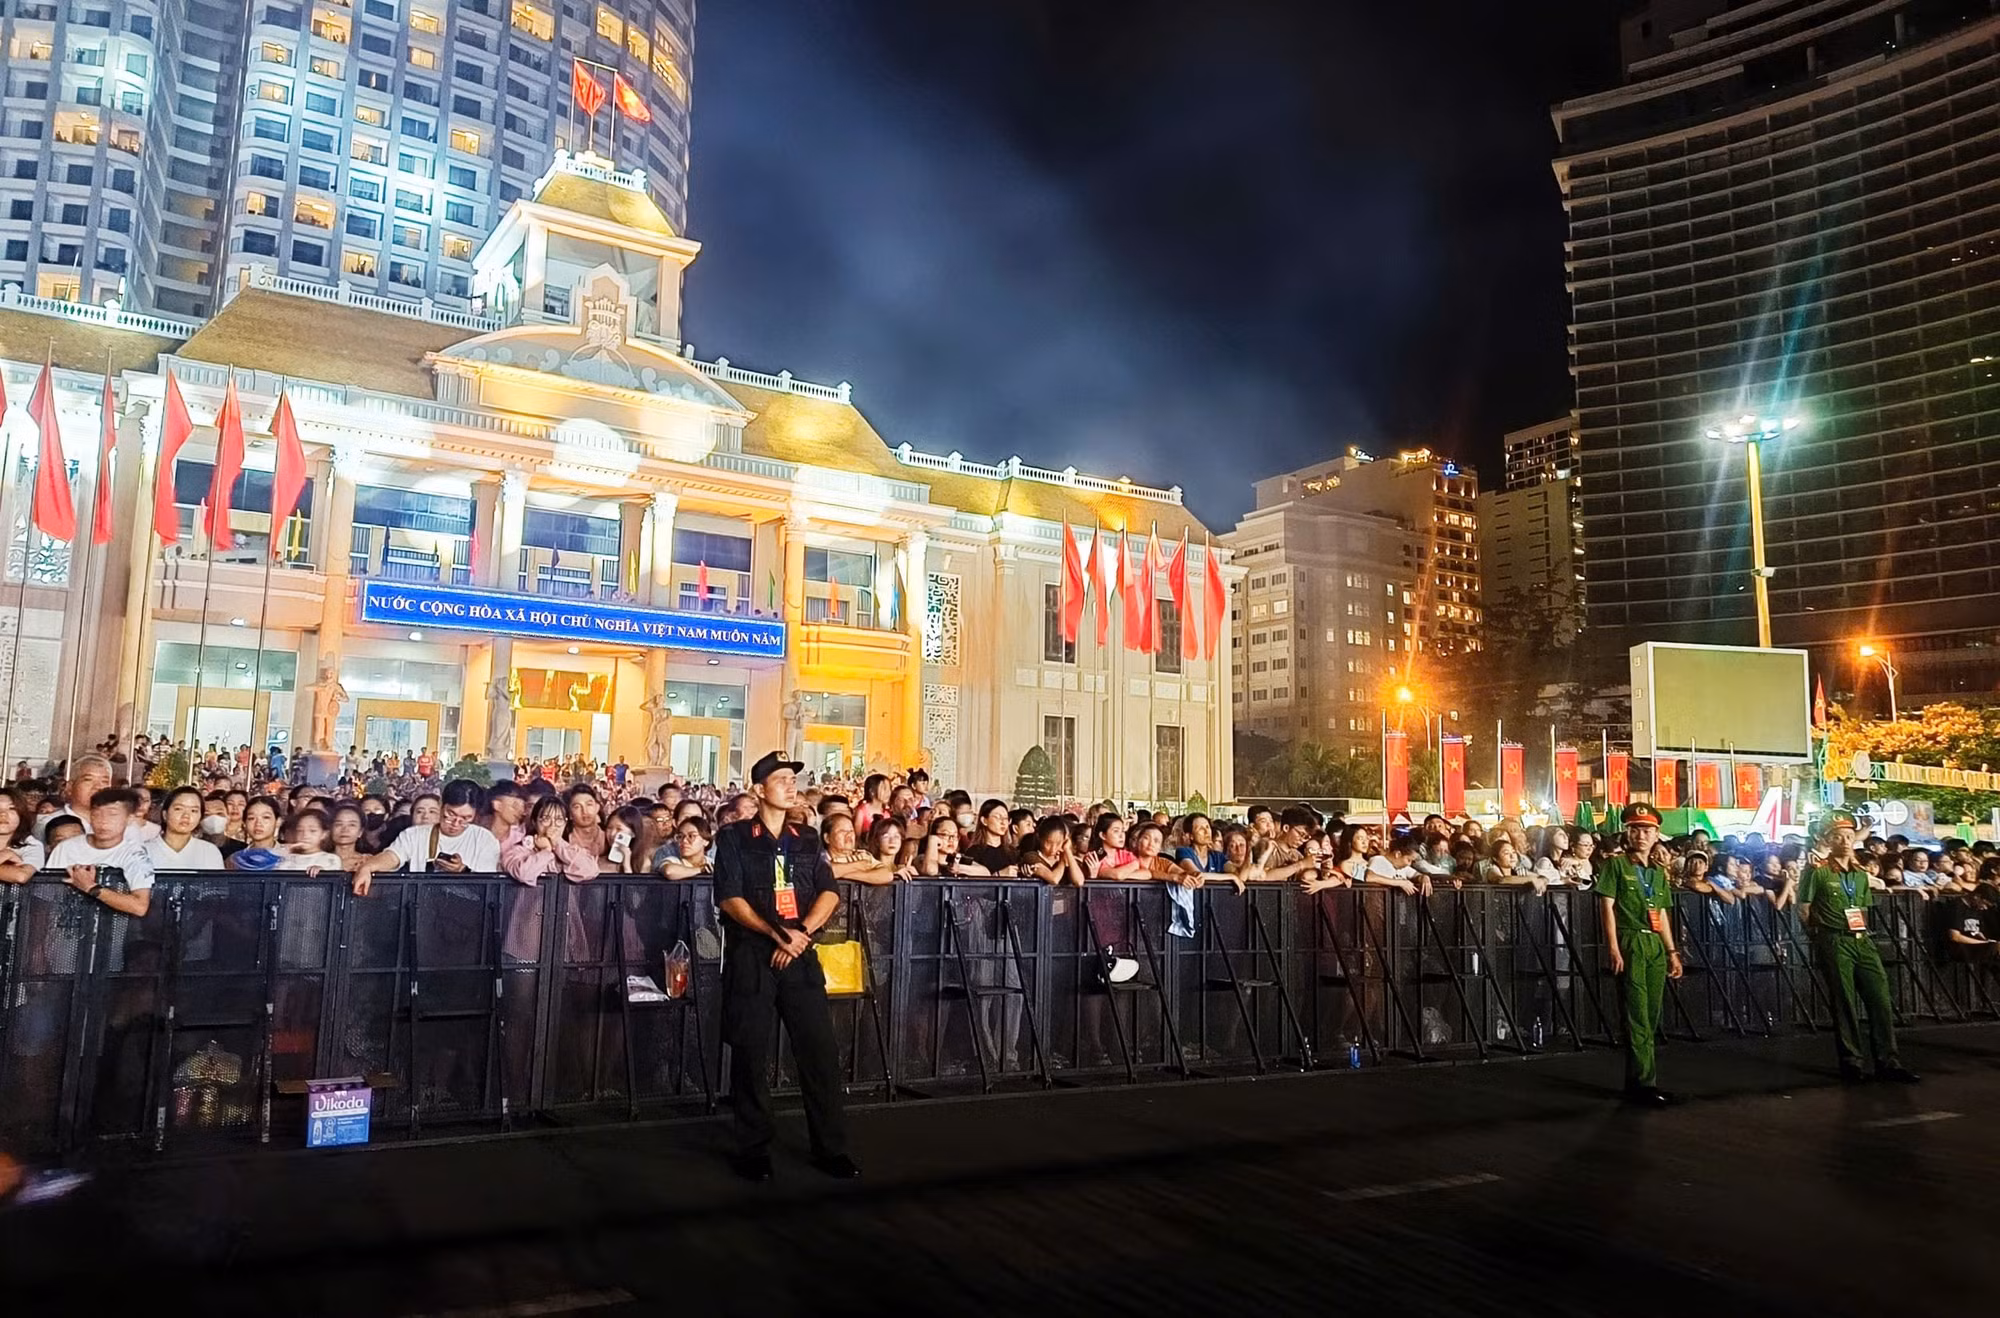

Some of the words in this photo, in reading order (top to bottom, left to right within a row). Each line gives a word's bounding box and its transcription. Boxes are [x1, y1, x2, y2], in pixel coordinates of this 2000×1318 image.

[368, 594, 417, 612] NƯỚC
[419, 600, 466, 617] CỘNG
[469, 604, 503, 620] HÒA
[505, 607, 526, 622] XÃ
[529, 611, 558, 627] HỘI
[559, 613, 593, 629] CHỦ
[594, 617, 641, 633] NGHĨA
[641, 622, 676, 638] VIỆT
[677, 627, 709, 640] NAM
[710, 630, 750, 643] MUÔN
[751, 633, 782, 647] NĂM
